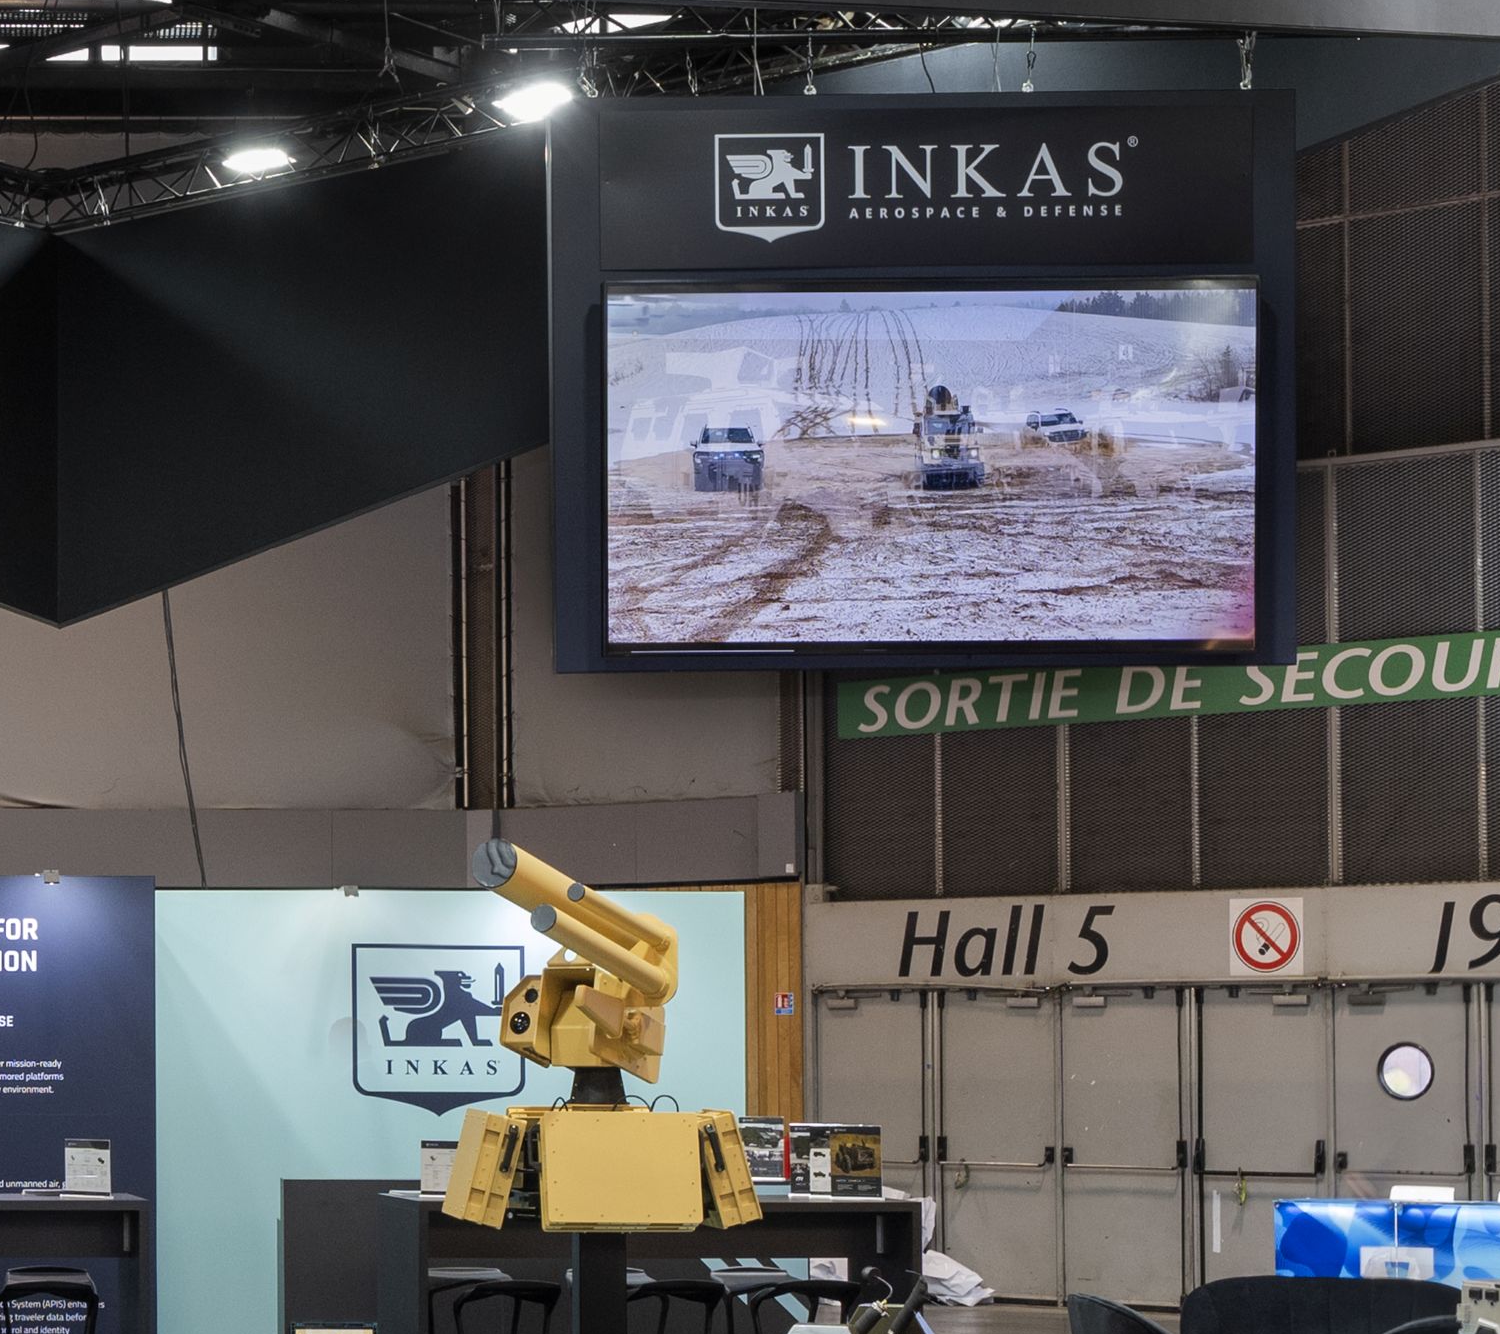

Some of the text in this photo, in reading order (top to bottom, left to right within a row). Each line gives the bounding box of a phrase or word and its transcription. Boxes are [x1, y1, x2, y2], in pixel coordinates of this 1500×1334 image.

[849, 203, 1124, 221] AEROSPACE & DEFENSE
[857, 667, 1083, 735] SORTIE
[1116, 666, 1202, 716] DE
[898, 903, 1117, 979] Hall 5
[6, 1059, 62, 1070] mission-ready
[25, 1072, 65, 1083] platforms
[2, 1085, 55, 1094] environment.
[5, 1178, 47, 1188] unmanned
[48, 1178, 61, 1190] air,
[11, 1299, 41, 1311] System
[42, 1299, 66, 1310] (APIS)
[15, 1313, 45, 1322] traveler
[46, 1313, 64, 1321] data
[23, 1326, 39, 1334] and
